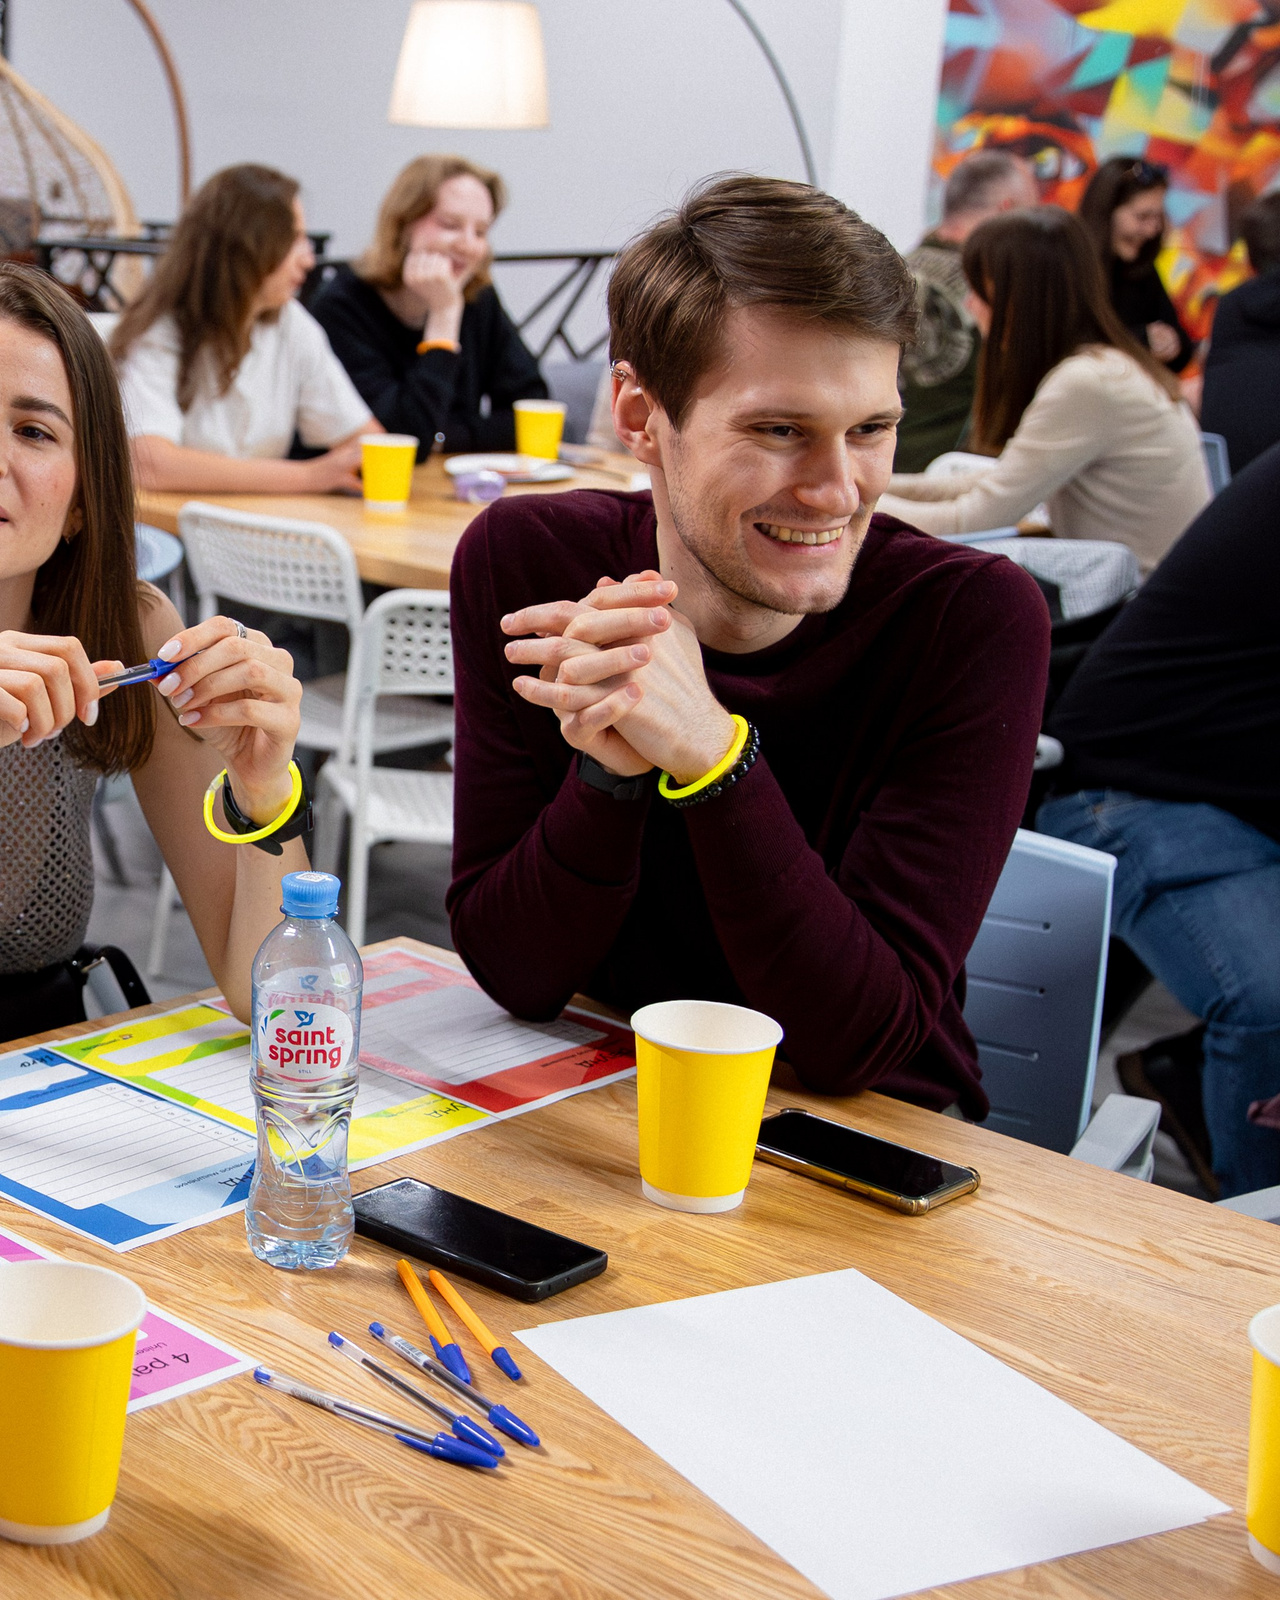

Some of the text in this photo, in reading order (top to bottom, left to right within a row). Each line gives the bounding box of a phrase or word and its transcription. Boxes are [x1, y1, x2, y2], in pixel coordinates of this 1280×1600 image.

[275, 1026, 336, 1046] saint
[268, 1044, 341, 1069] spring
[171, 1352, 190, 1364] 4
